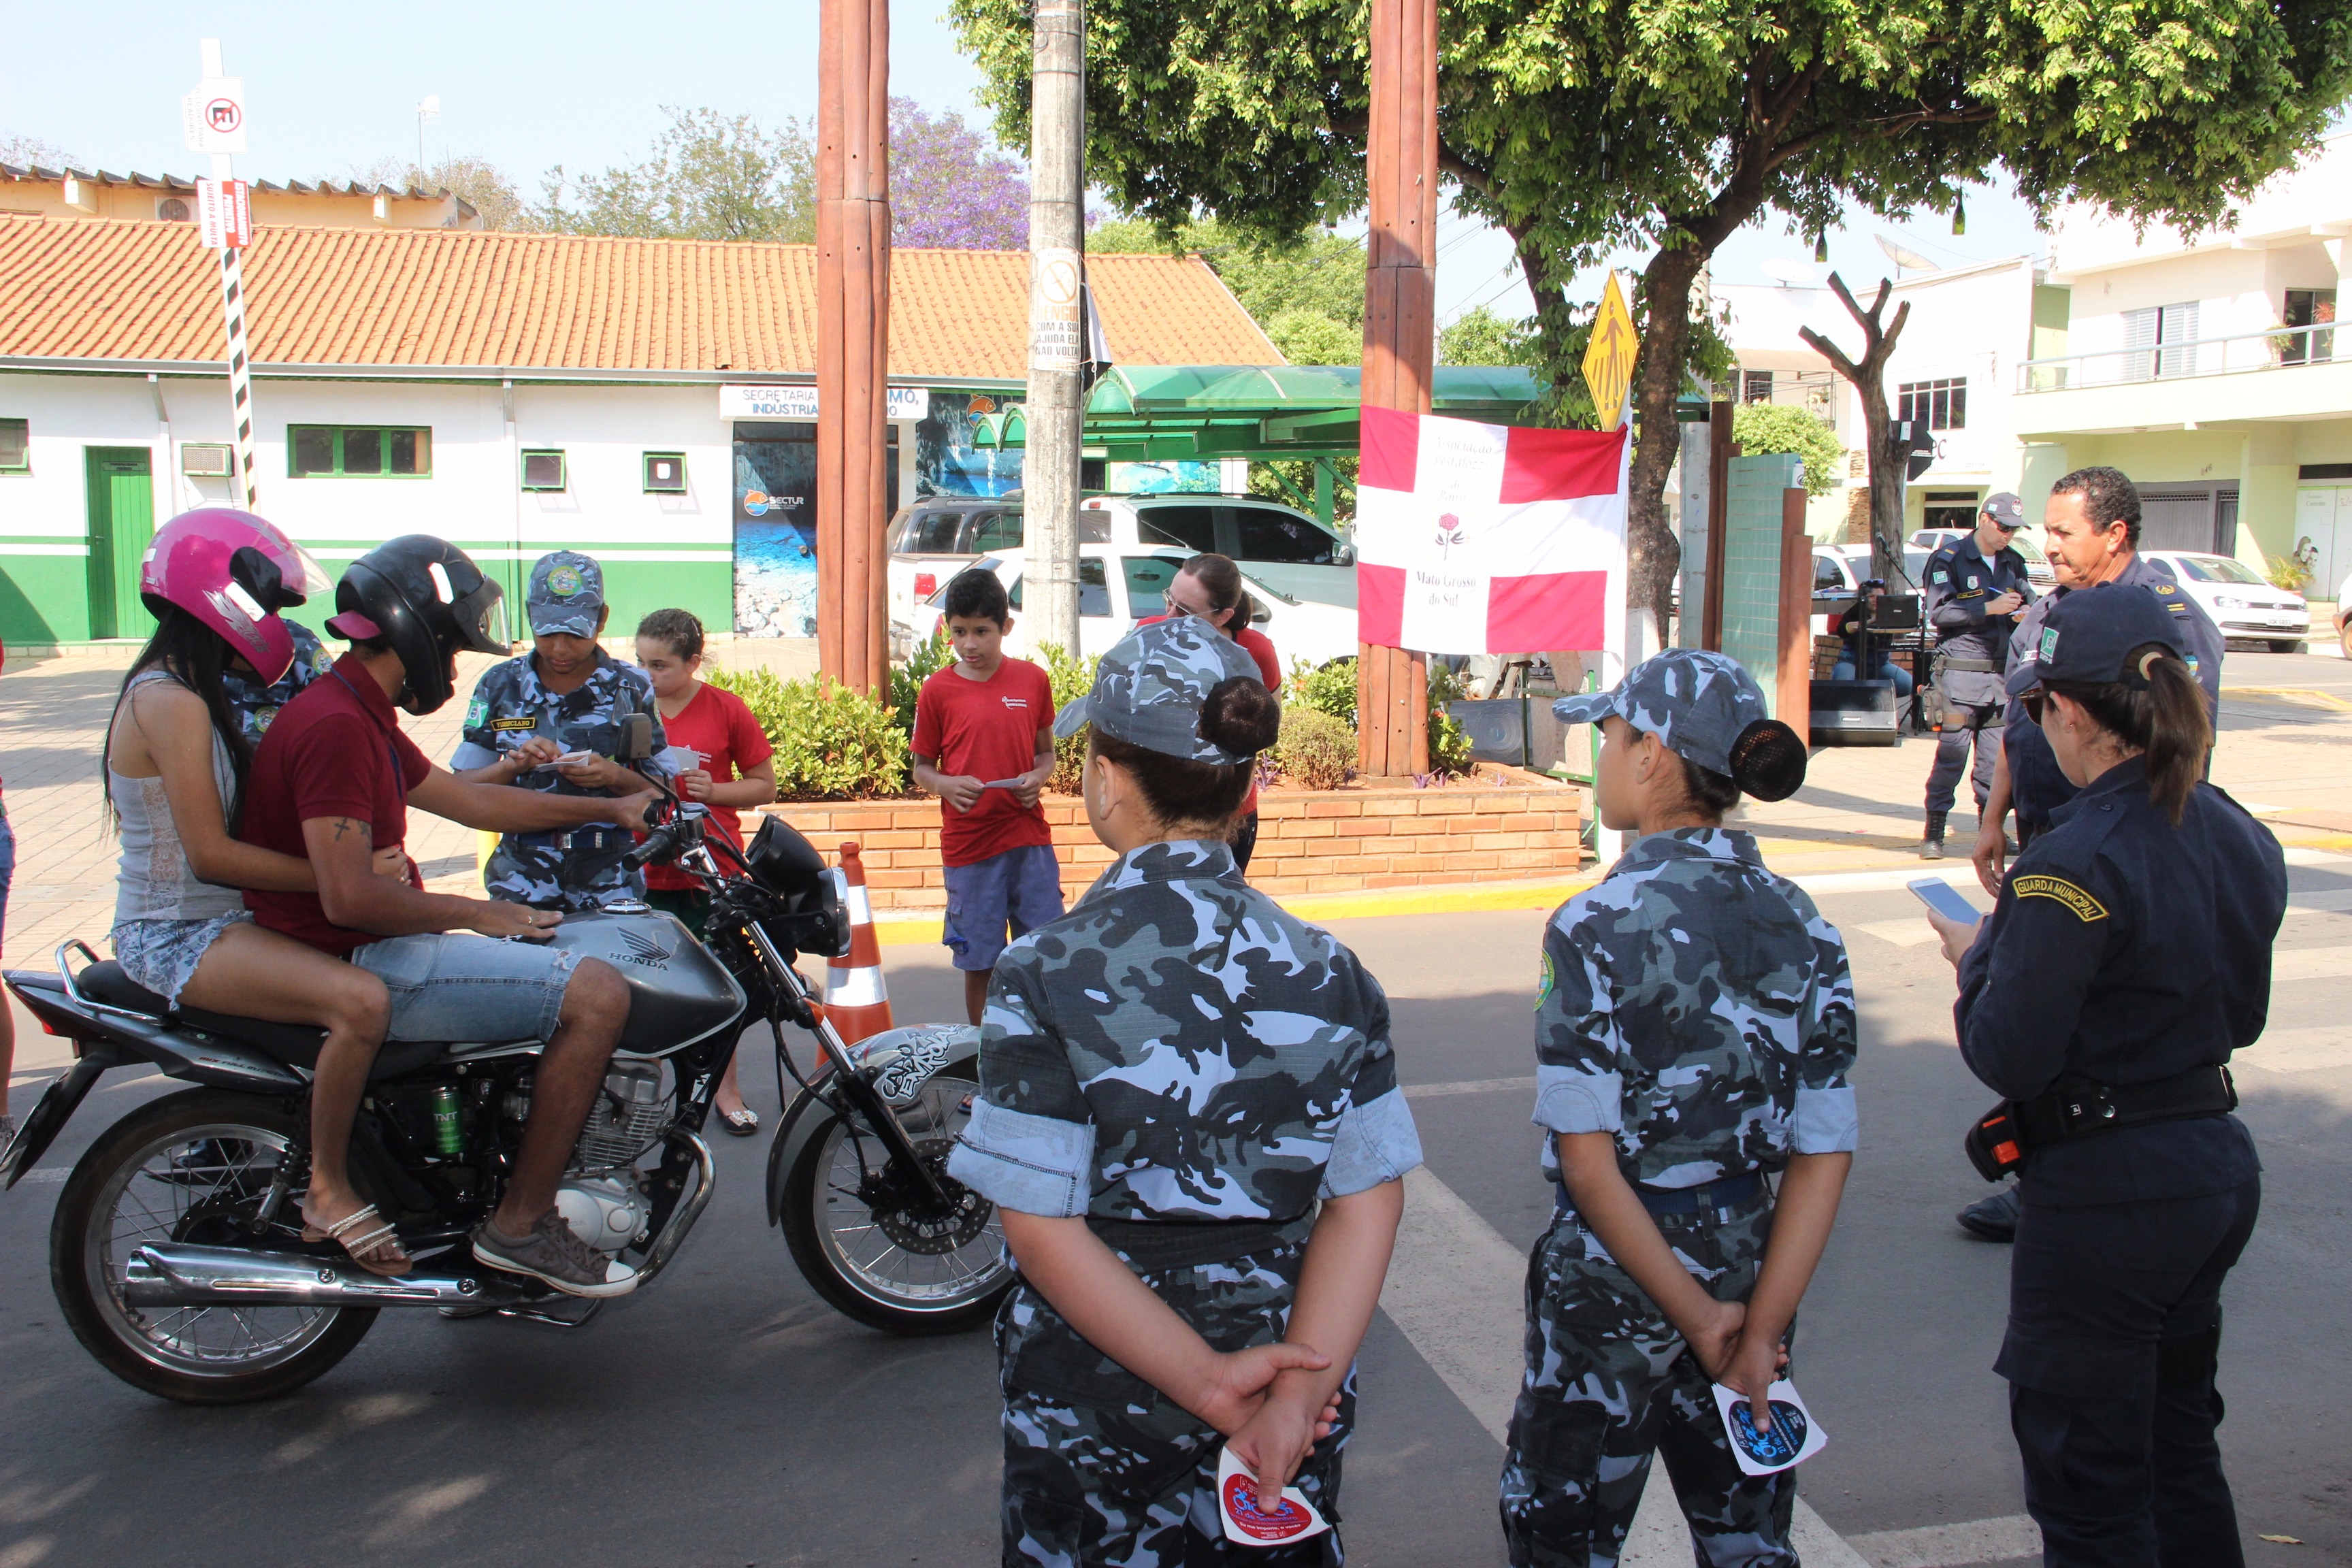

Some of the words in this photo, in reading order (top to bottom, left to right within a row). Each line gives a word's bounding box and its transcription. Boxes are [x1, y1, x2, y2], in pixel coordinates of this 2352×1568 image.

[206, 182, 216, 212] SUJEITO
[223, 194, 235, 233] PRIVATIVO
[235, 182, 248, 246] ESTACIONAMENTO
[209, 221, 218, 245] MULTA
[1058, 322, 1064, 331] A
[1036, 334, 1065, 344] AJUDA
[742, 389, 816, 401] SECRETARIA
[769, 496, 804, 505] SECTUR
[1416, 570, 1441, 587] Mato
[1443, 574, 1477, 589] Grosso
[1429, 593, 1440, 606] do
[1443, 593, 1459, 607] Sul
[2017, 879, 2053, 893] GUARDA
[2053, 882, 2098, 918] MUNICIPAL
[608, 951, 670, 972] HONDA
[434, 1111, 458, 1122] TNT
[1778, 1446, 1786, 1454] 21
